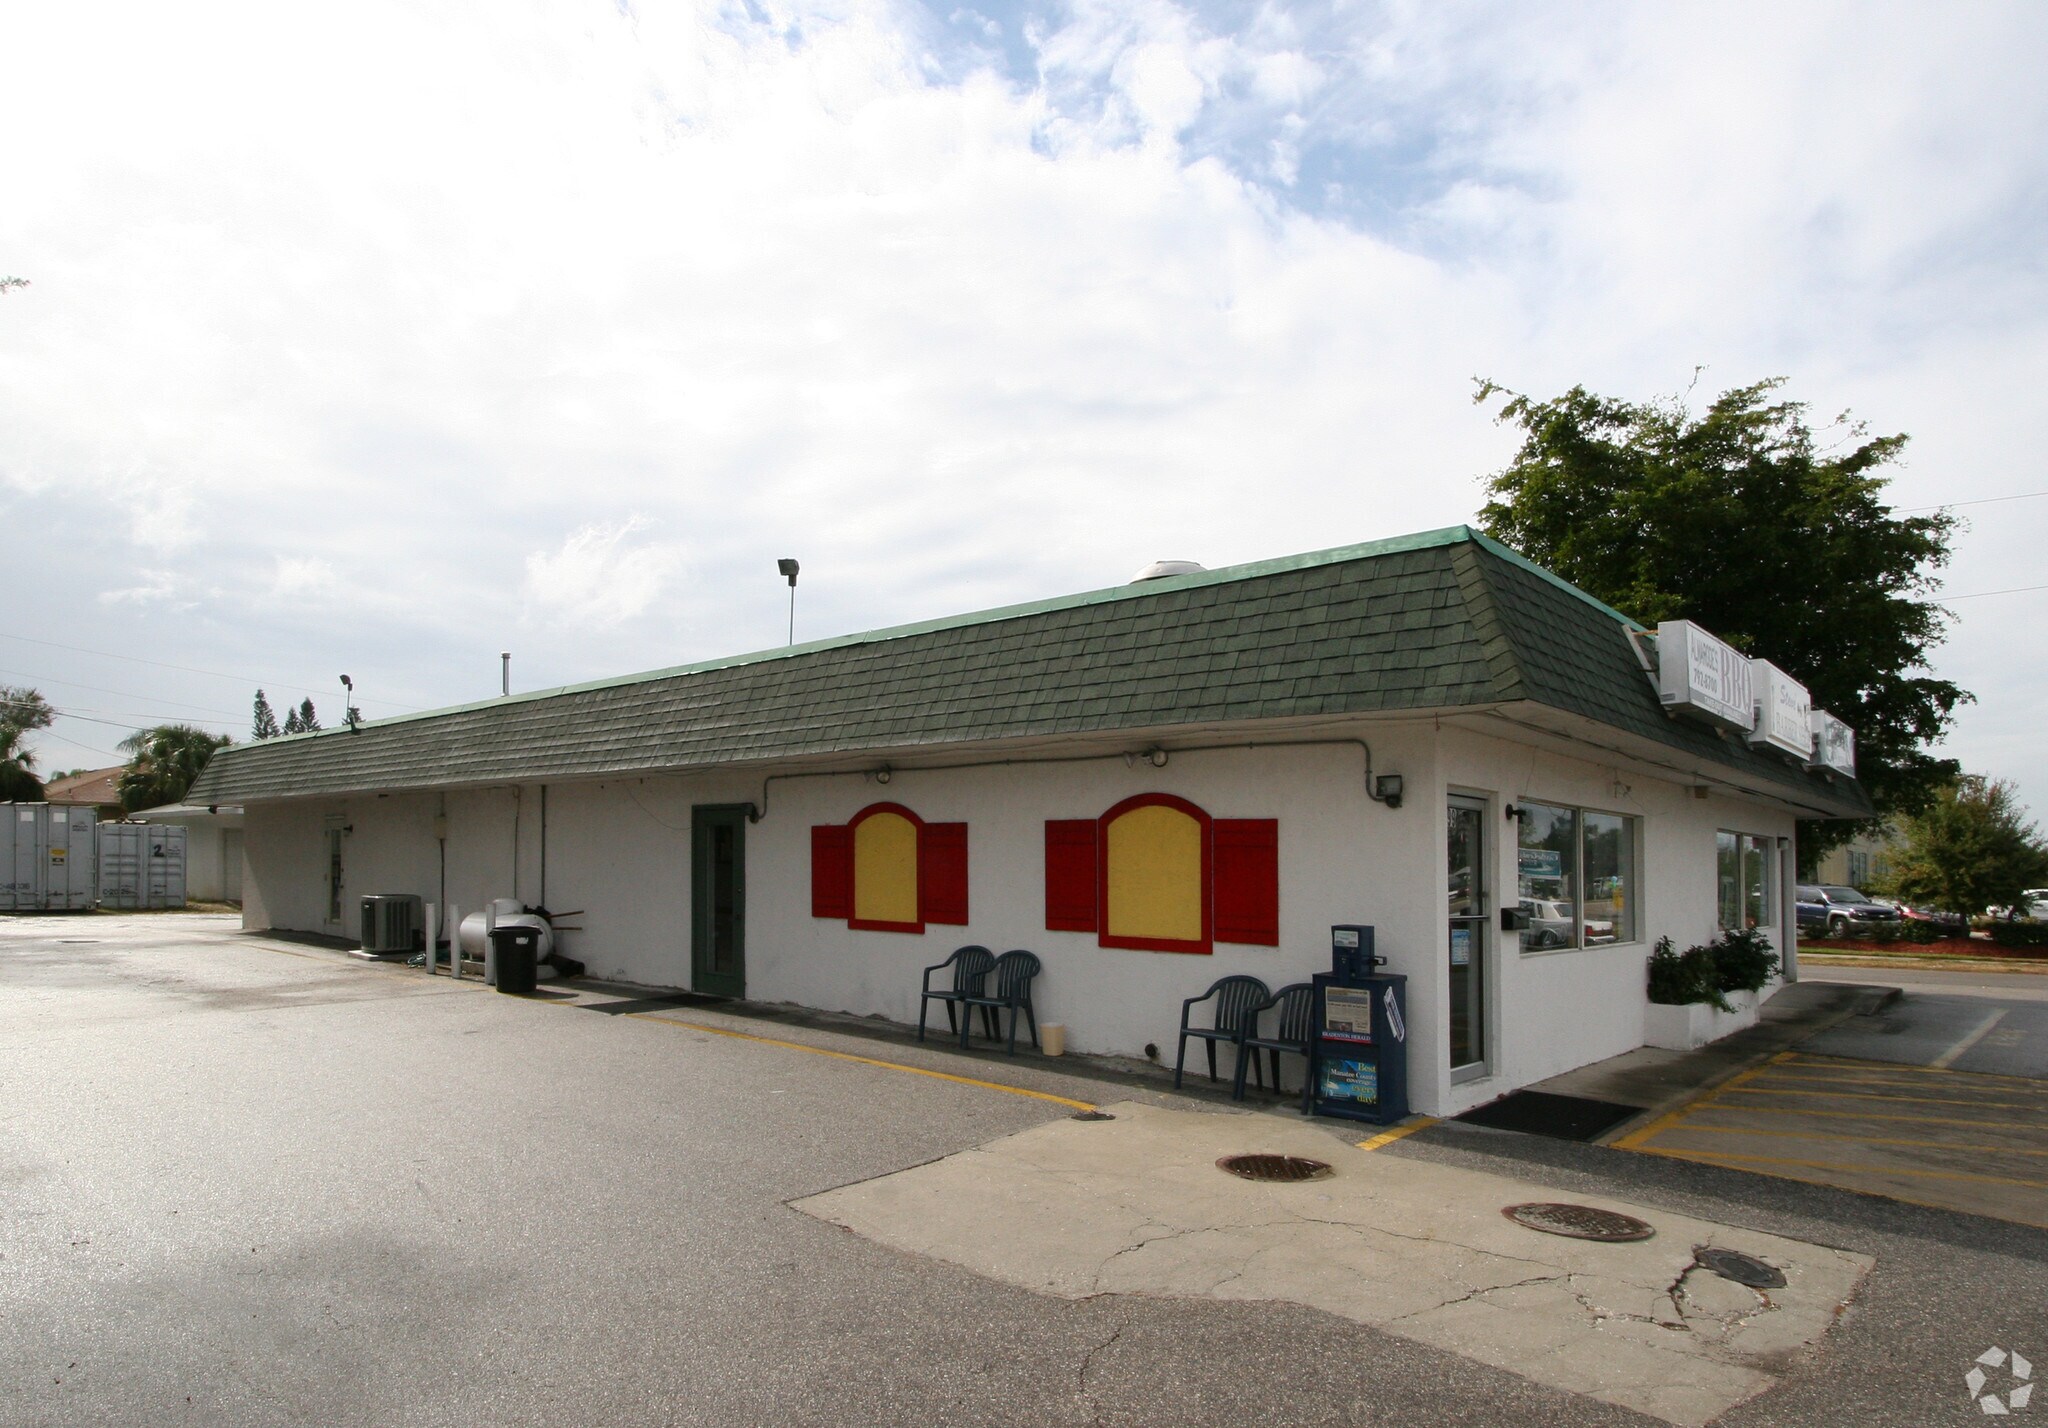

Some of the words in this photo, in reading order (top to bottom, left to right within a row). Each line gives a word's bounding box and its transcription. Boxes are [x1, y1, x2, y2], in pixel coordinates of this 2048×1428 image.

[1719, 646, 1752, 715] BBQ
[153, 844, 164, 857] 2
[1358, 1062, 1376, 1072] Best
[1331, 1068, 1355, 1078] Manatee
[1352, 1085, 1377, 1094] every
[1357, 1093, 1376, 1105] day!
